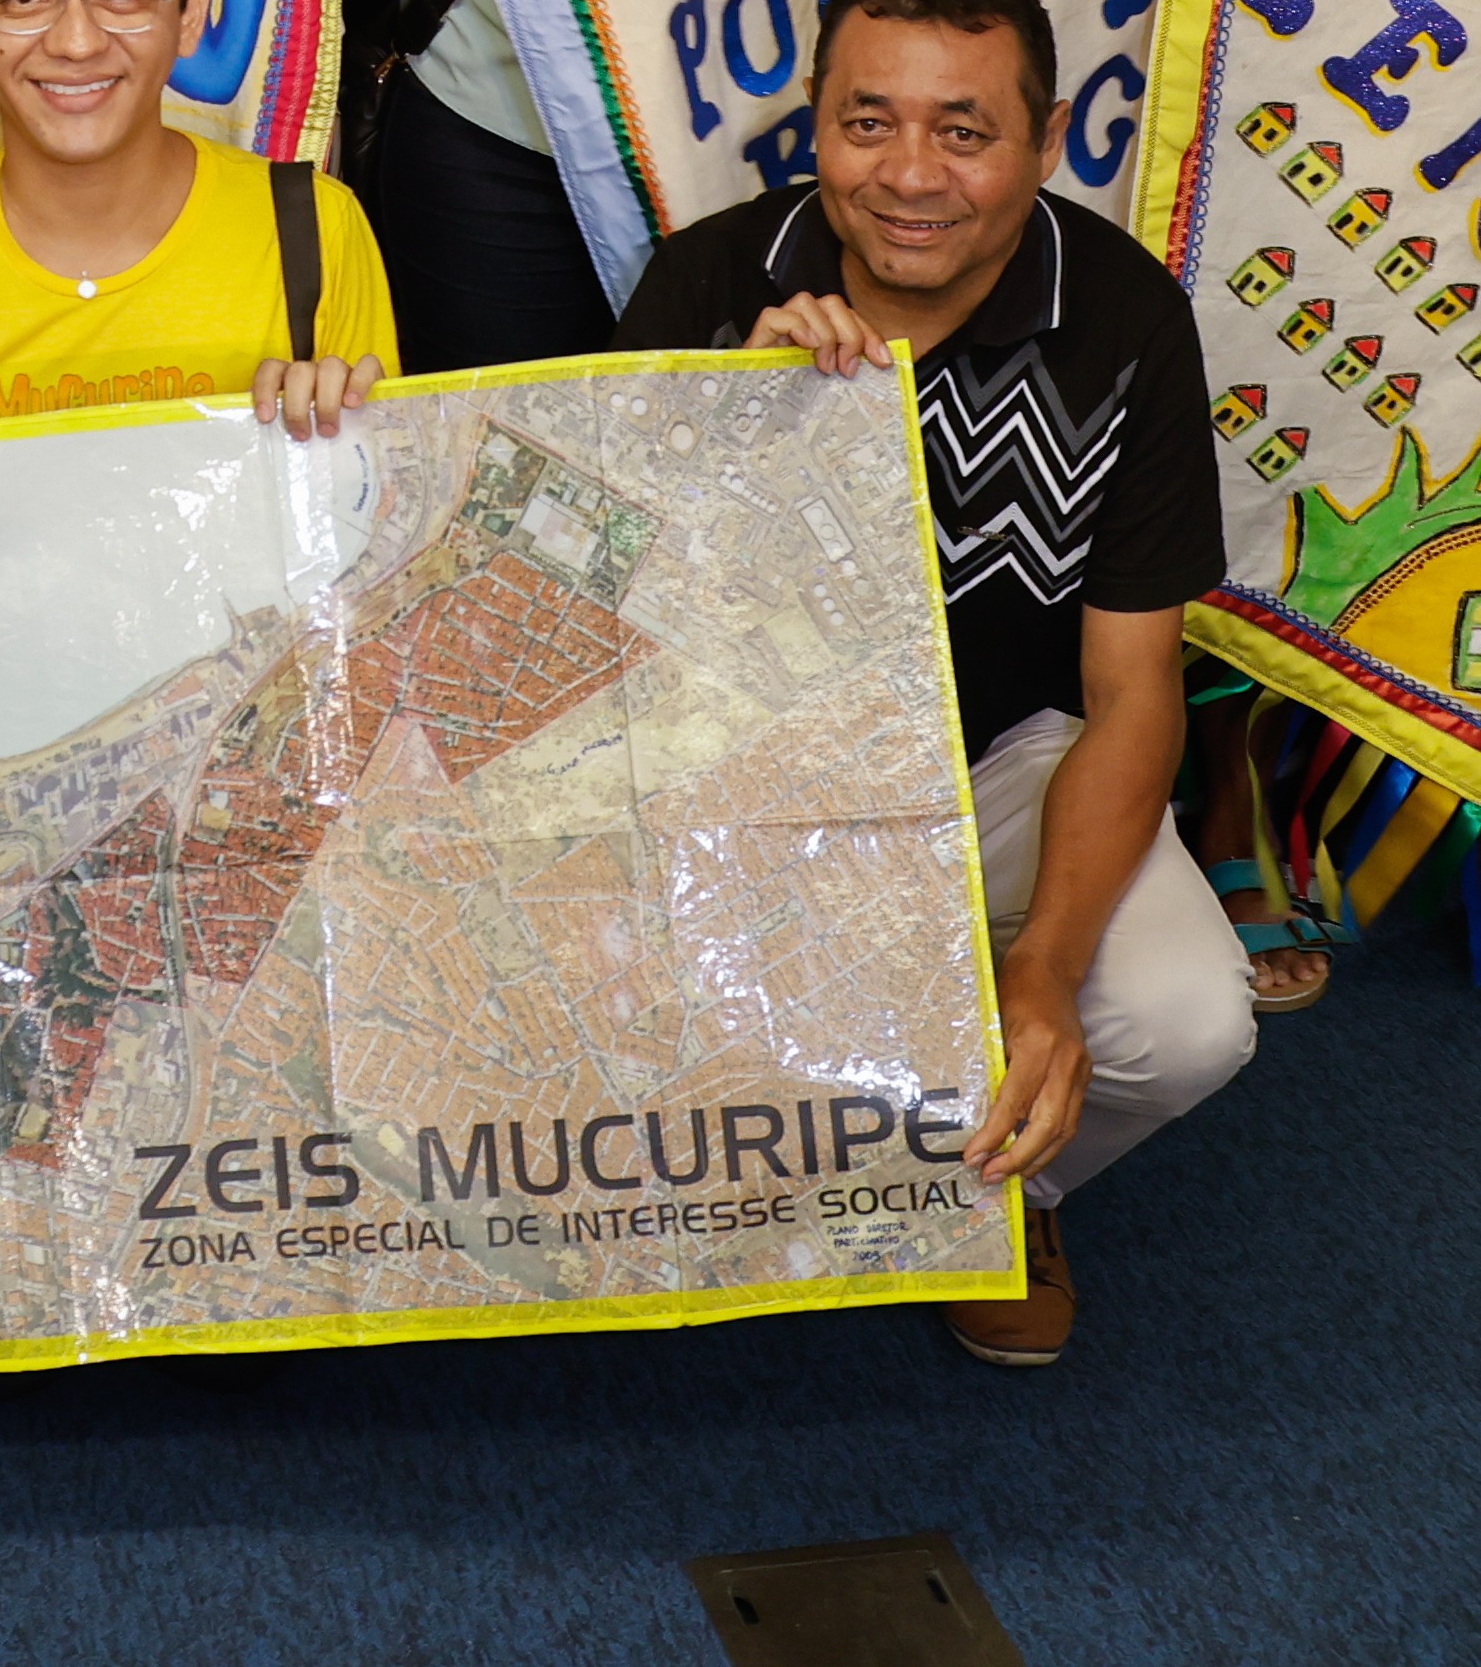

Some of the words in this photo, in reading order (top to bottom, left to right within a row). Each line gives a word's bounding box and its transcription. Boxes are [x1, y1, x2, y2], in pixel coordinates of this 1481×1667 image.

[133, 1133, 363, 1218] ZEIS
[417, 1088, 967, 1203] MUCURIPE
[139, 1235, 256, 1269] ZONA
[276, 1218, 467, 1258] ESPECIAL
[482, 1212, 546, 1246] DE
[560, 1191, 799, 1240] INTERESSE
[817, 1179, 977, 1220] SOCIAL
